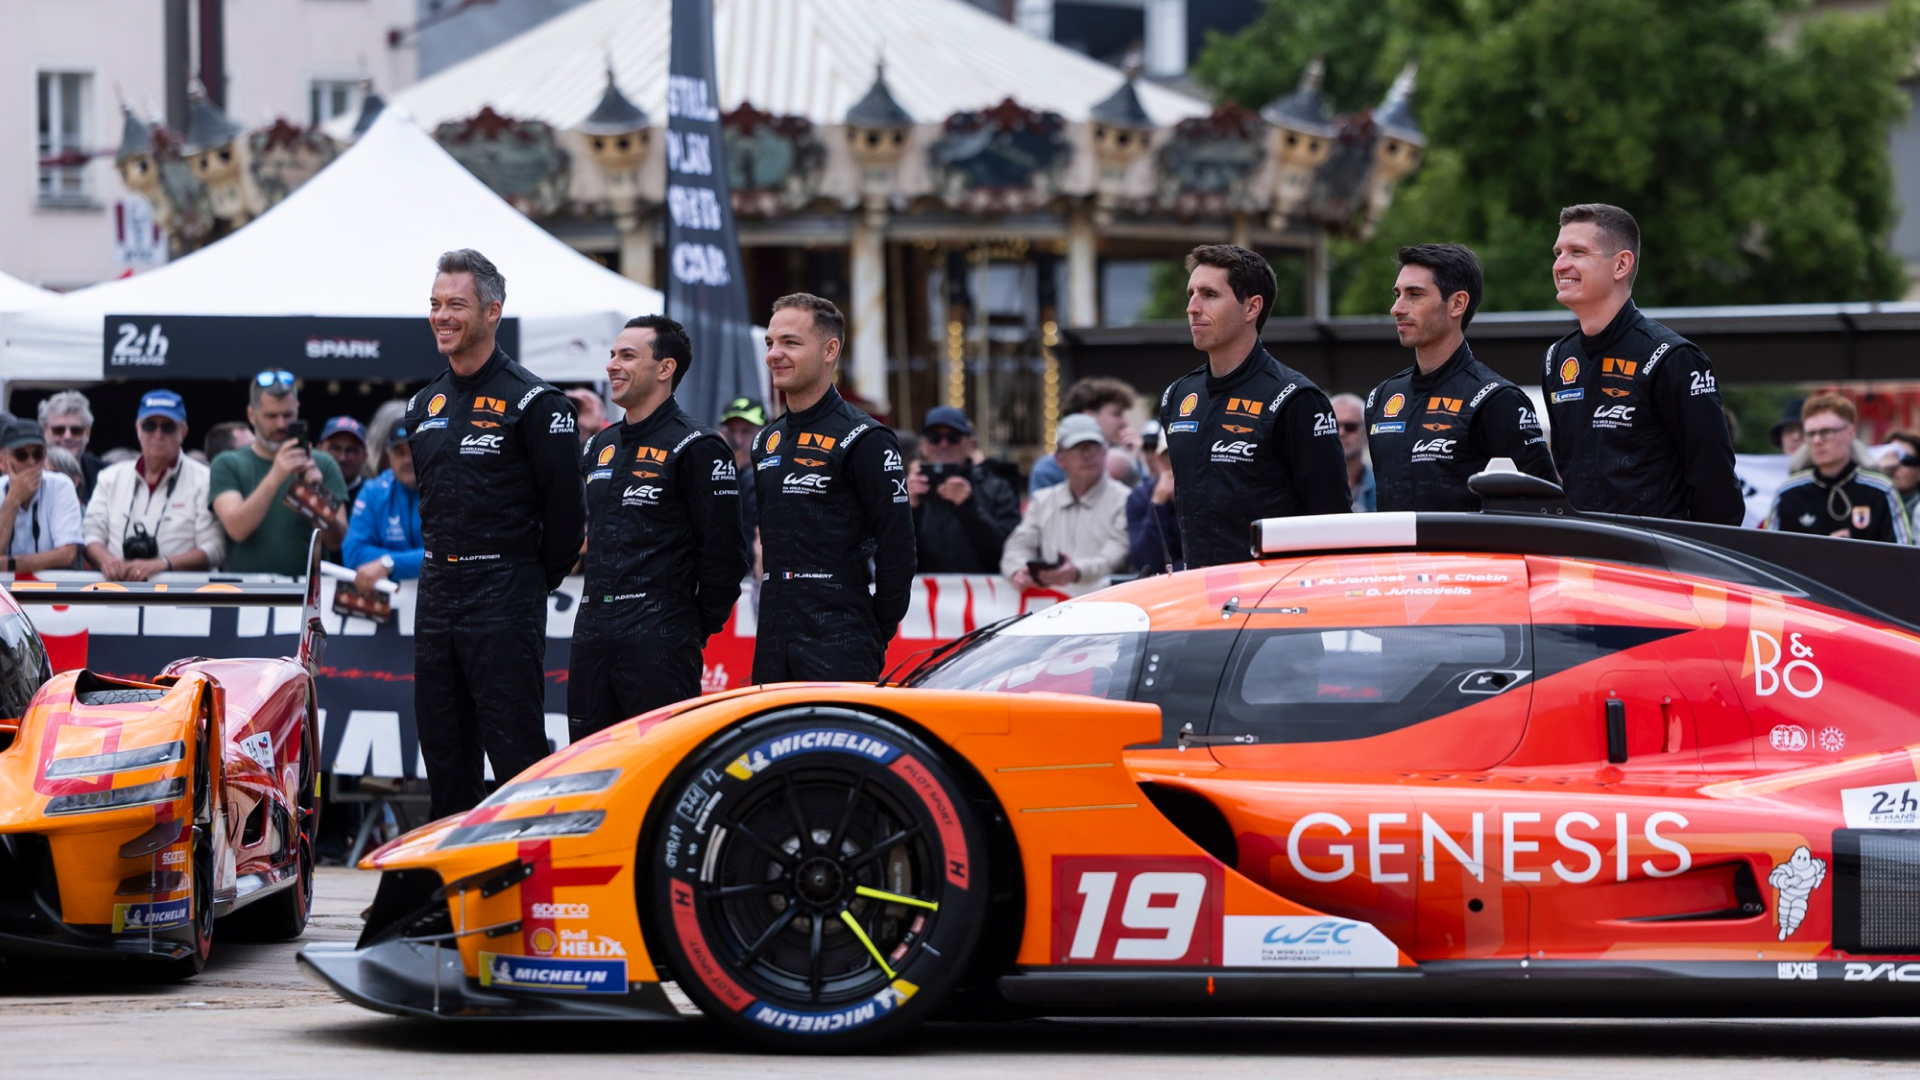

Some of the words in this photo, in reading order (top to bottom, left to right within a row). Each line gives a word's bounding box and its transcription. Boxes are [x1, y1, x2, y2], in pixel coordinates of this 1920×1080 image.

[113, 322, 169, 357] 24h
[305, 338, 380, 359] SPARK
[1642, 342, 1670, 376] sparco
[1690, 369, 1715, 390] 24h
[1269, 383, 1297, 413] sparco
[1700, 387, 1716, 395] MANS
[550, 412, 575, 429] 24h
[1314, 411, 1337, 431] 24h
[1593, 405, 1636, 421] WEC
[460, 434, 504, 448] WEC
[1211, 439, 1258, 456] WEC
[1412, 438, 1457, 453] WEC
[712, 459, 736, 476] 24h
[783, 472, 832, 488] WEC
[623, 485, 663, 499] WEC
[1339, 574, 1406, 584] Jaminet
[1453, 573, 1508, 582] Chatin
[1366, 588, 1382, 597] D.
[1384, 586, 1472, 596] Juncadella
[770, 731, 889, 759] MICHELIN
[903, 763, 929, 792] PILOT
[928, 791, 954, 827] SPORT
[1869, 788, 1918, 815] 24h
[1286, 811, 1692, 884] GENESIS
[949, 860, 966, 879] H
[675, 889, 691, 908] H
[144, 908, 187, 922] MICHELIN
[531, 903, 590, 919] sparco
[1069, 871, 1208, 961] 19
[560, 929, 588, 940] Shell
[1262, 922, 1358, 945] WEC
[560, 937, 627, 956] HELIX
[515, 968, 608, 983] MICHELIN
[1777, 962, 1818, 980] HEXIS
[756, 1003, 875, 1031] MICHELIN
